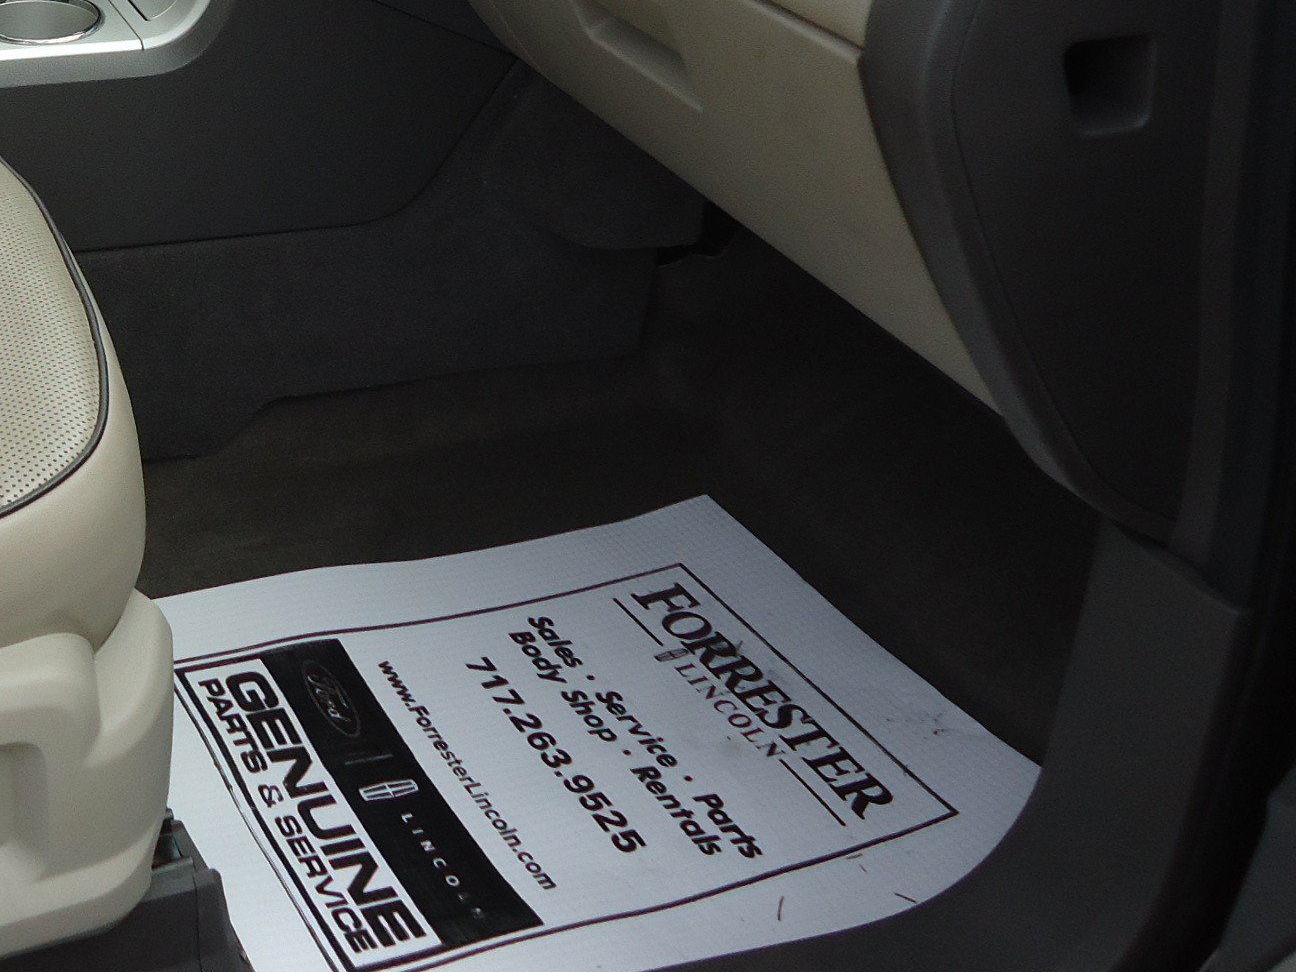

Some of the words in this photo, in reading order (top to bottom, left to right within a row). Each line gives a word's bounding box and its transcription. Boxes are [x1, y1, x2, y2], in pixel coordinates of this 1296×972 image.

[197, 678, 269, 774] PARTS
[257, 783, 285, 809] &
[273, 814, 380, 954] SERVICE
[224, 671, 427, 949] GENUINE
[377, 659, 557, 890] www.ForresterLincoln.com
[464, 656, 647, 853] 717.263.9525
[508, 630, 567, 684] Body
[561, 689, 618, 743] Shop
[630, 764, 723, 856] Rentals
[528, 615, 583, 669] Sales
[595, 690, 678, 768] Service
[692, 793, 763, 859] Parts
[631, 582, 894, 820] FORRESTER
[674, 662, 787, 758] LINCOLN
